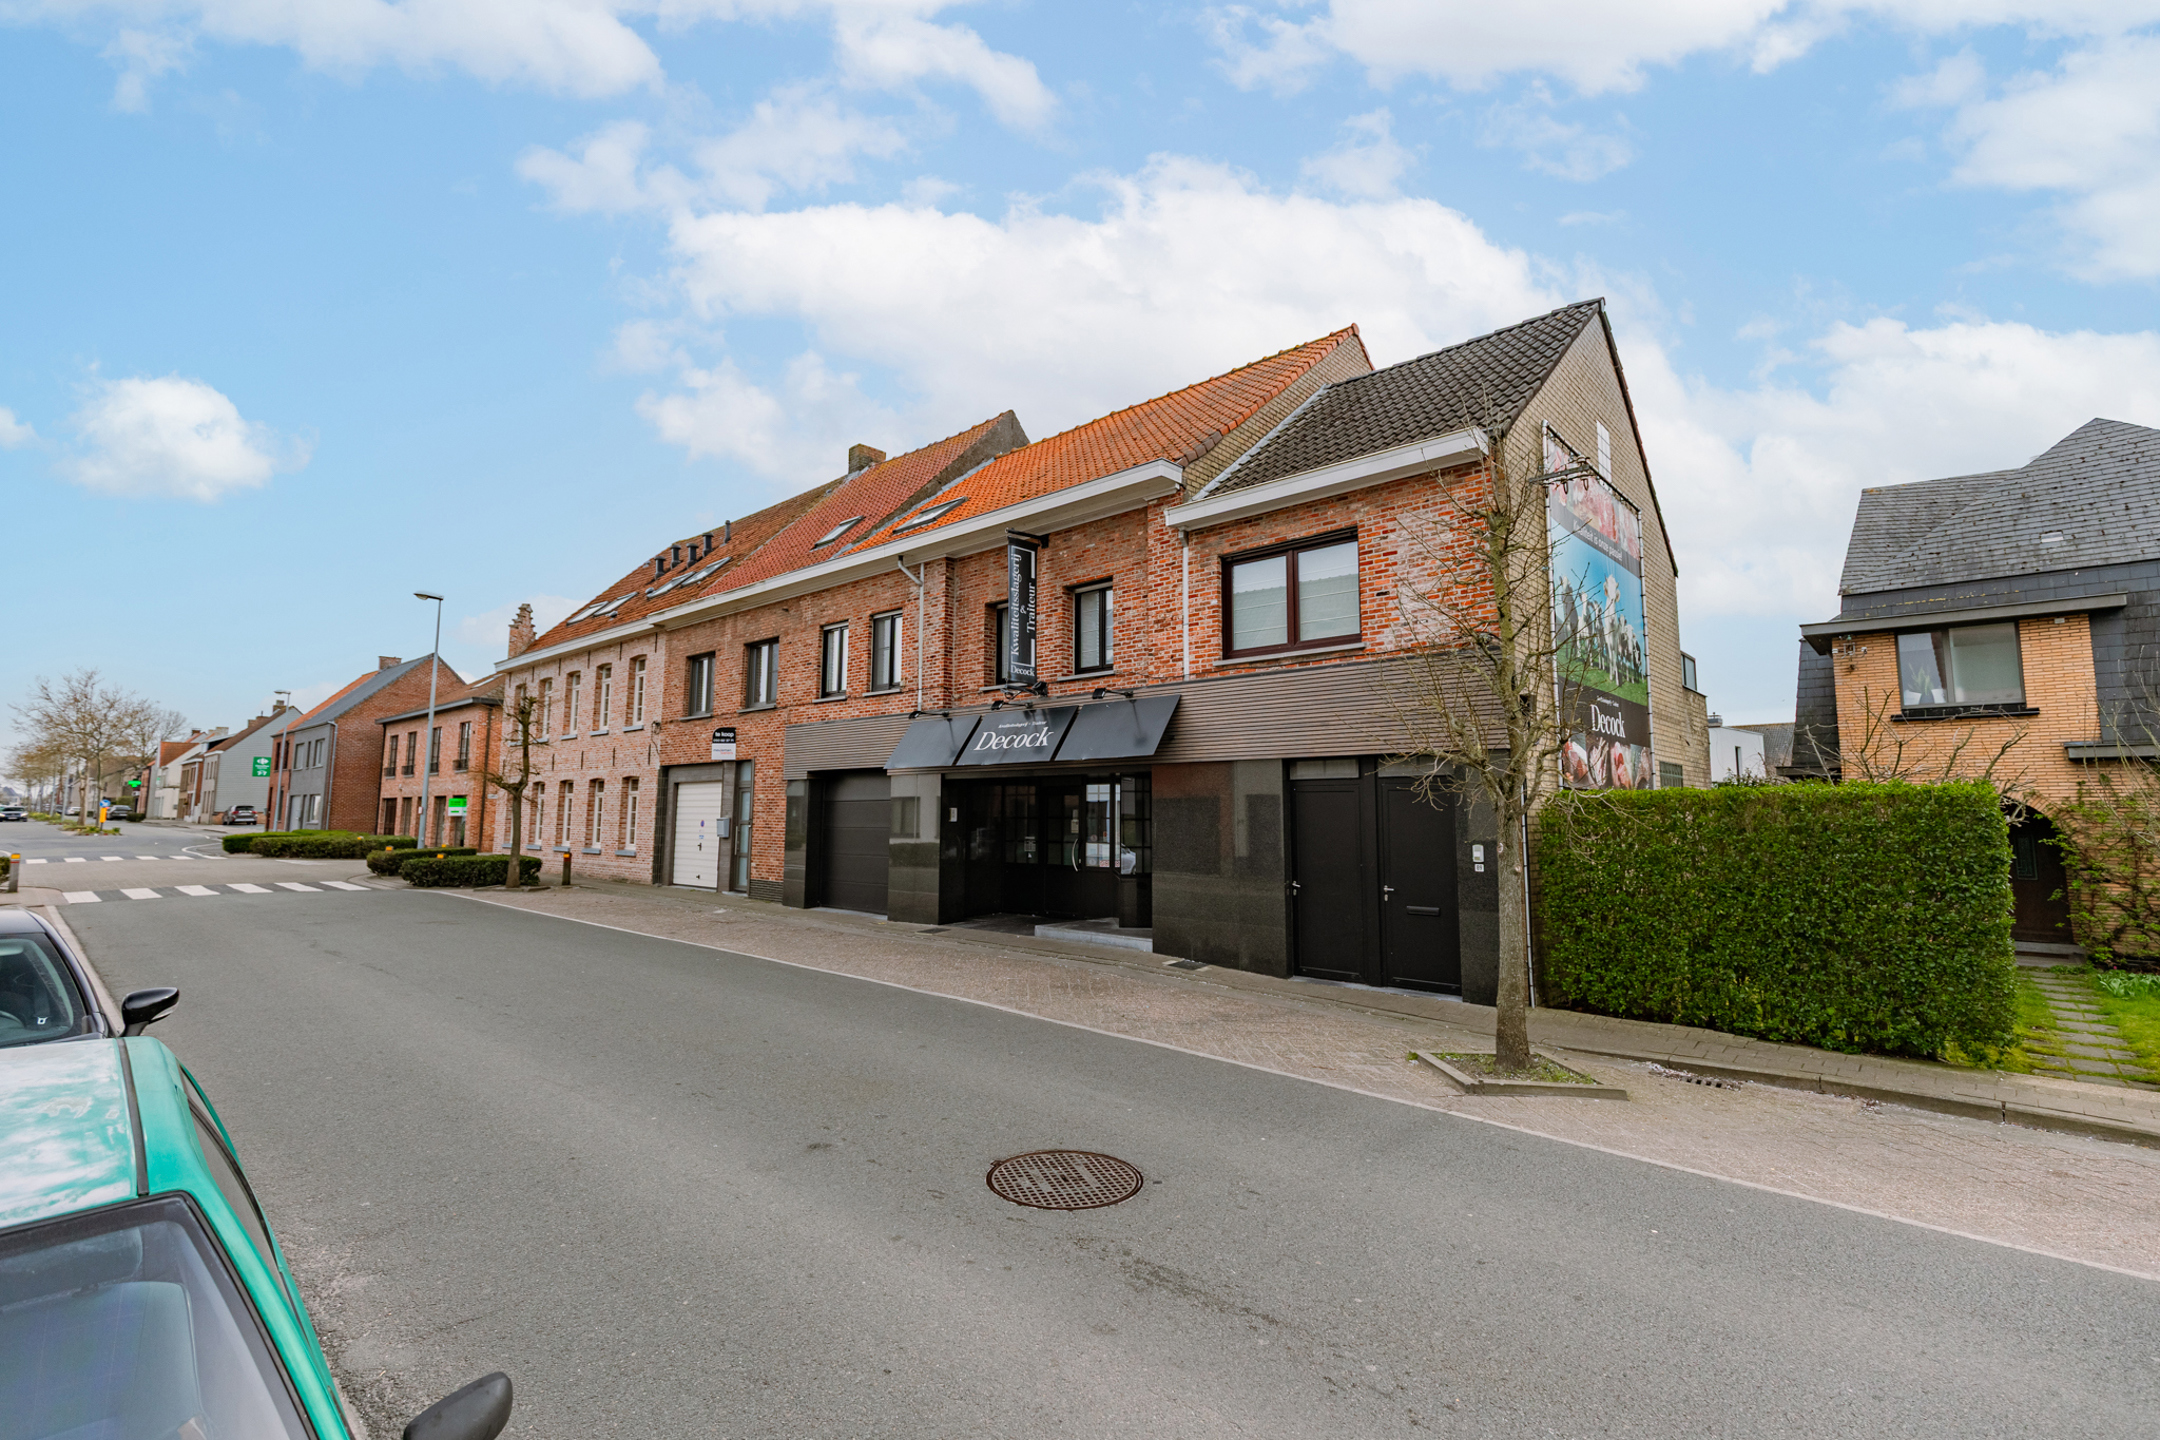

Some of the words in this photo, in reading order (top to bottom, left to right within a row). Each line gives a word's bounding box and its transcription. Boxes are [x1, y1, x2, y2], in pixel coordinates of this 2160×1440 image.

[1010, 553, 1022, 656] Kwaliteitsslagerij
[1020, 605, 1026, 615] &
[1027, 582, 1036, 633] Traiteur
[1010, 664, 1036, 677] Decock
[1590, 704, 1626, 738] Decock
[973, 726, 1055, 751] Decock
